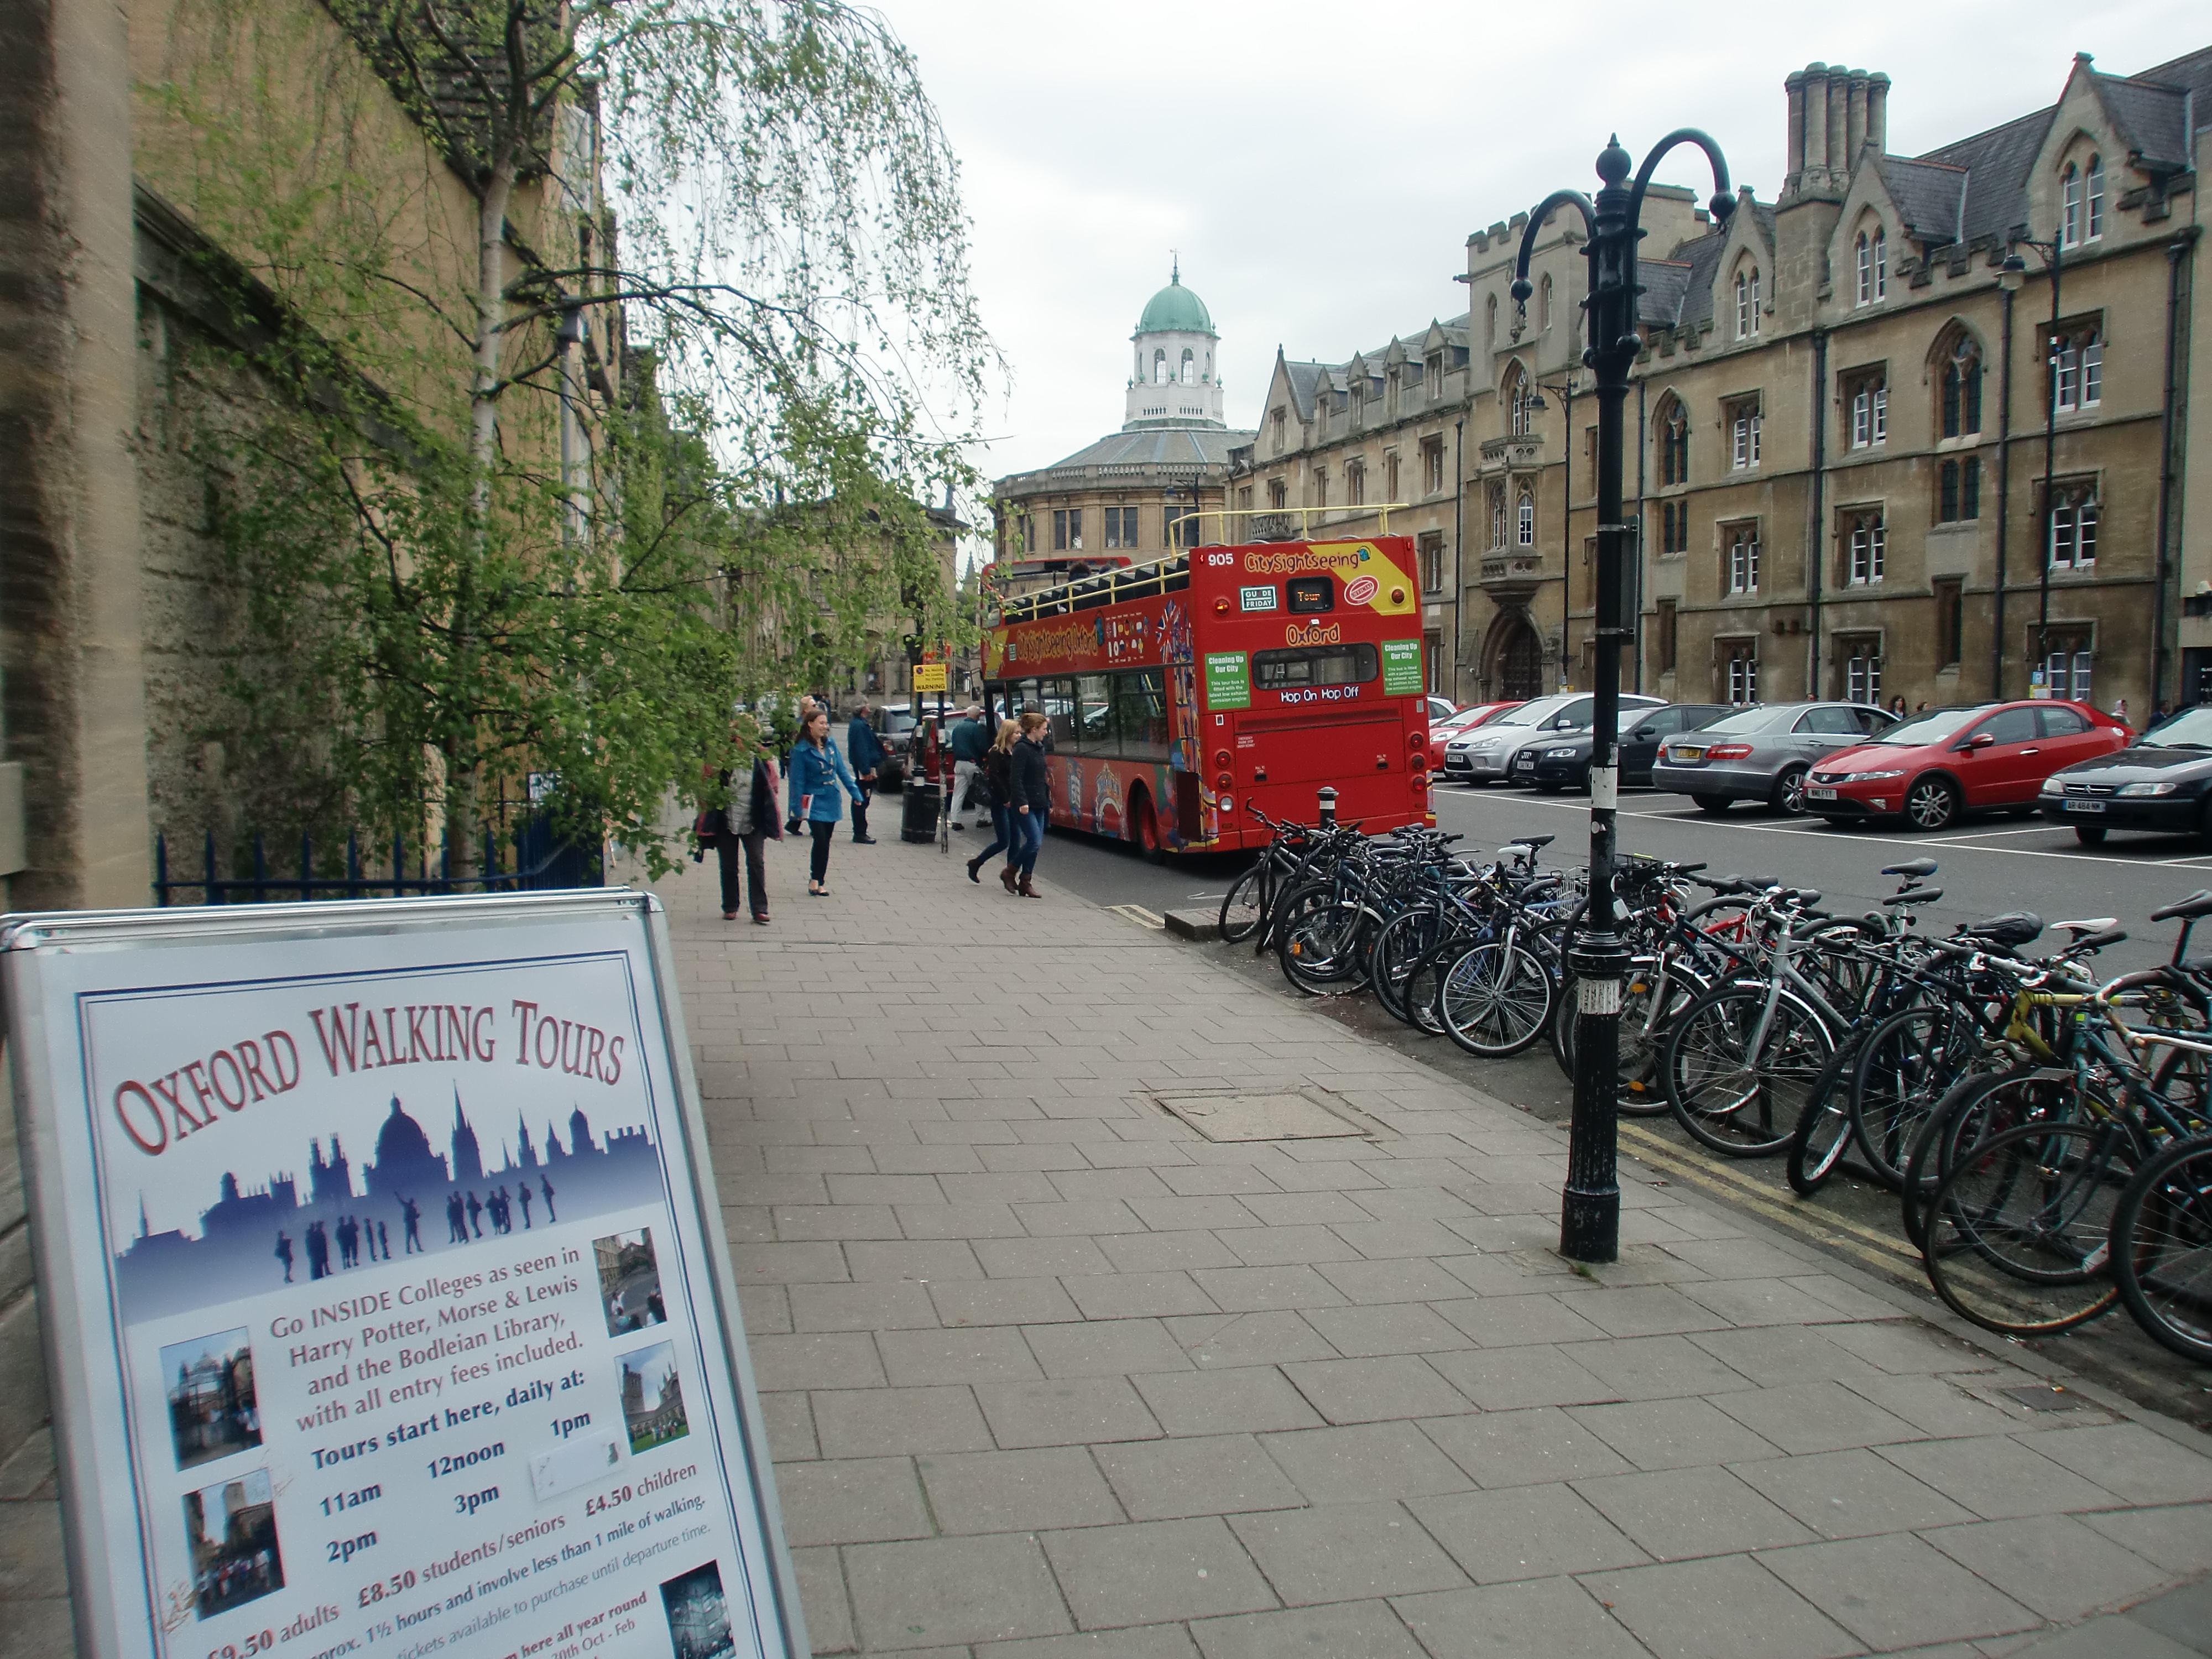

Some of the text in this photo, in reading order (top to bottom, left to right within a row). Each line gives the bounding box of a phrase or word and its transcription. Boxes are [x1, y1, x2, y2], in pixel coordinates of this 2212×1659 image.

[1208, 553, 1234, 566] 905
[1245, 599, 1272, 608] FRIDAY
[1297, 591, 1321, 602] Tour
[1287, 624, 1340, 645] Oxford
[1281, 686, 1359, 703] Hop On Hop Off
[113, 999, 625, 1156] OXFORD WALKING TOURS
[269, 1247, 580, 1339] Go INSIDE Colleges as seen in
[289, 1276, 578, 1368] Harry Potter, Morse & Lewis
[297, 1332, 584, 1432] with all entry fees included.
[308, 1311, 566, 1395] and the Bodleian Library,
[311, 1369, 585, 1470] Tours start here, daily at:
[319, 1410, 591, 1516] 11am 12noon 1pm
[280, 1603, 340, 1643] adults
[357, 1570, 416, 1609] £8.50
[422, 1513, 566, 1583] students/seniors
[585, 1485, 632, 1517] £4.50
[637, 1464, 696, 1497] children
[326, 1485, 500, 1563] 2pm 3pm
[396, 1603, 441, 1631] hours
[446, 1585, 473, 1610] and
[477, 1567, 529, 1596] involve
[532, 1554, 558, 1574] less
[562, 1542, 591, 1562] than
[595, 1534, 602, 1547] 1
[607, 1522, 635, 1542] mile
[638, 1511, 651, 1528] of
[654, 1493, 706, 1523] walking.
[449, 1607, 510, 1644] available
[514, 1601, 528, 1614] to
[531, 1574, 588, 1609] purchase
[592, 1558, 620, 1580] until
[623, 1535, 680, 1567] departure
[681, 1522, 711, 1542] time.
[521, 1590, 647, 1658] here all year round
[582, 1632, 606, 1651] Oct
[615, 1618, 635, 1636] Feb
